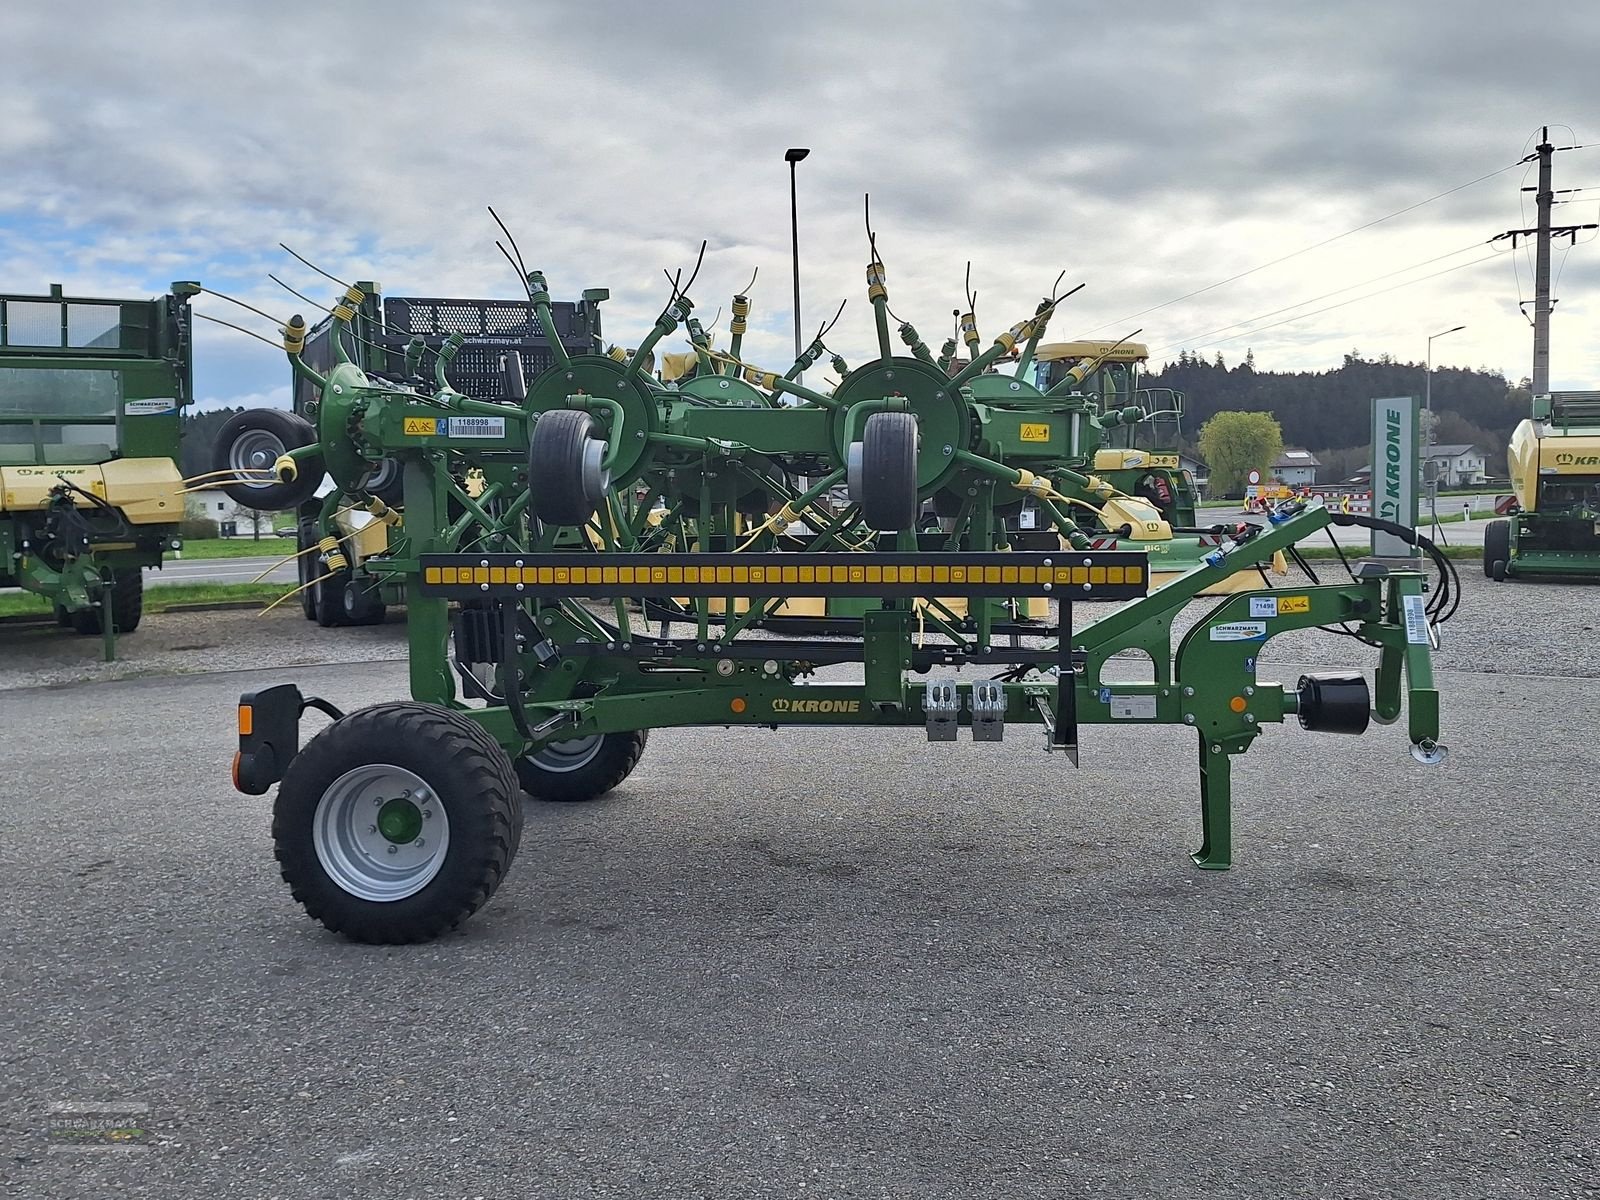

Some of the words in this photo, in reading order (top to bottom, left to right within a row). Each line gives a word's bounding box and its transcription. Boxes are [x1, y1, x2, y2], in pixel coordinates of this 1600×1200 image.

[458, 418, 489, 426] 1188998
[1386, 408, 1400, 499] KRONE
[1407, 608, 1416, 635] 1188998
[791, 700, 860, 712] KRONE
